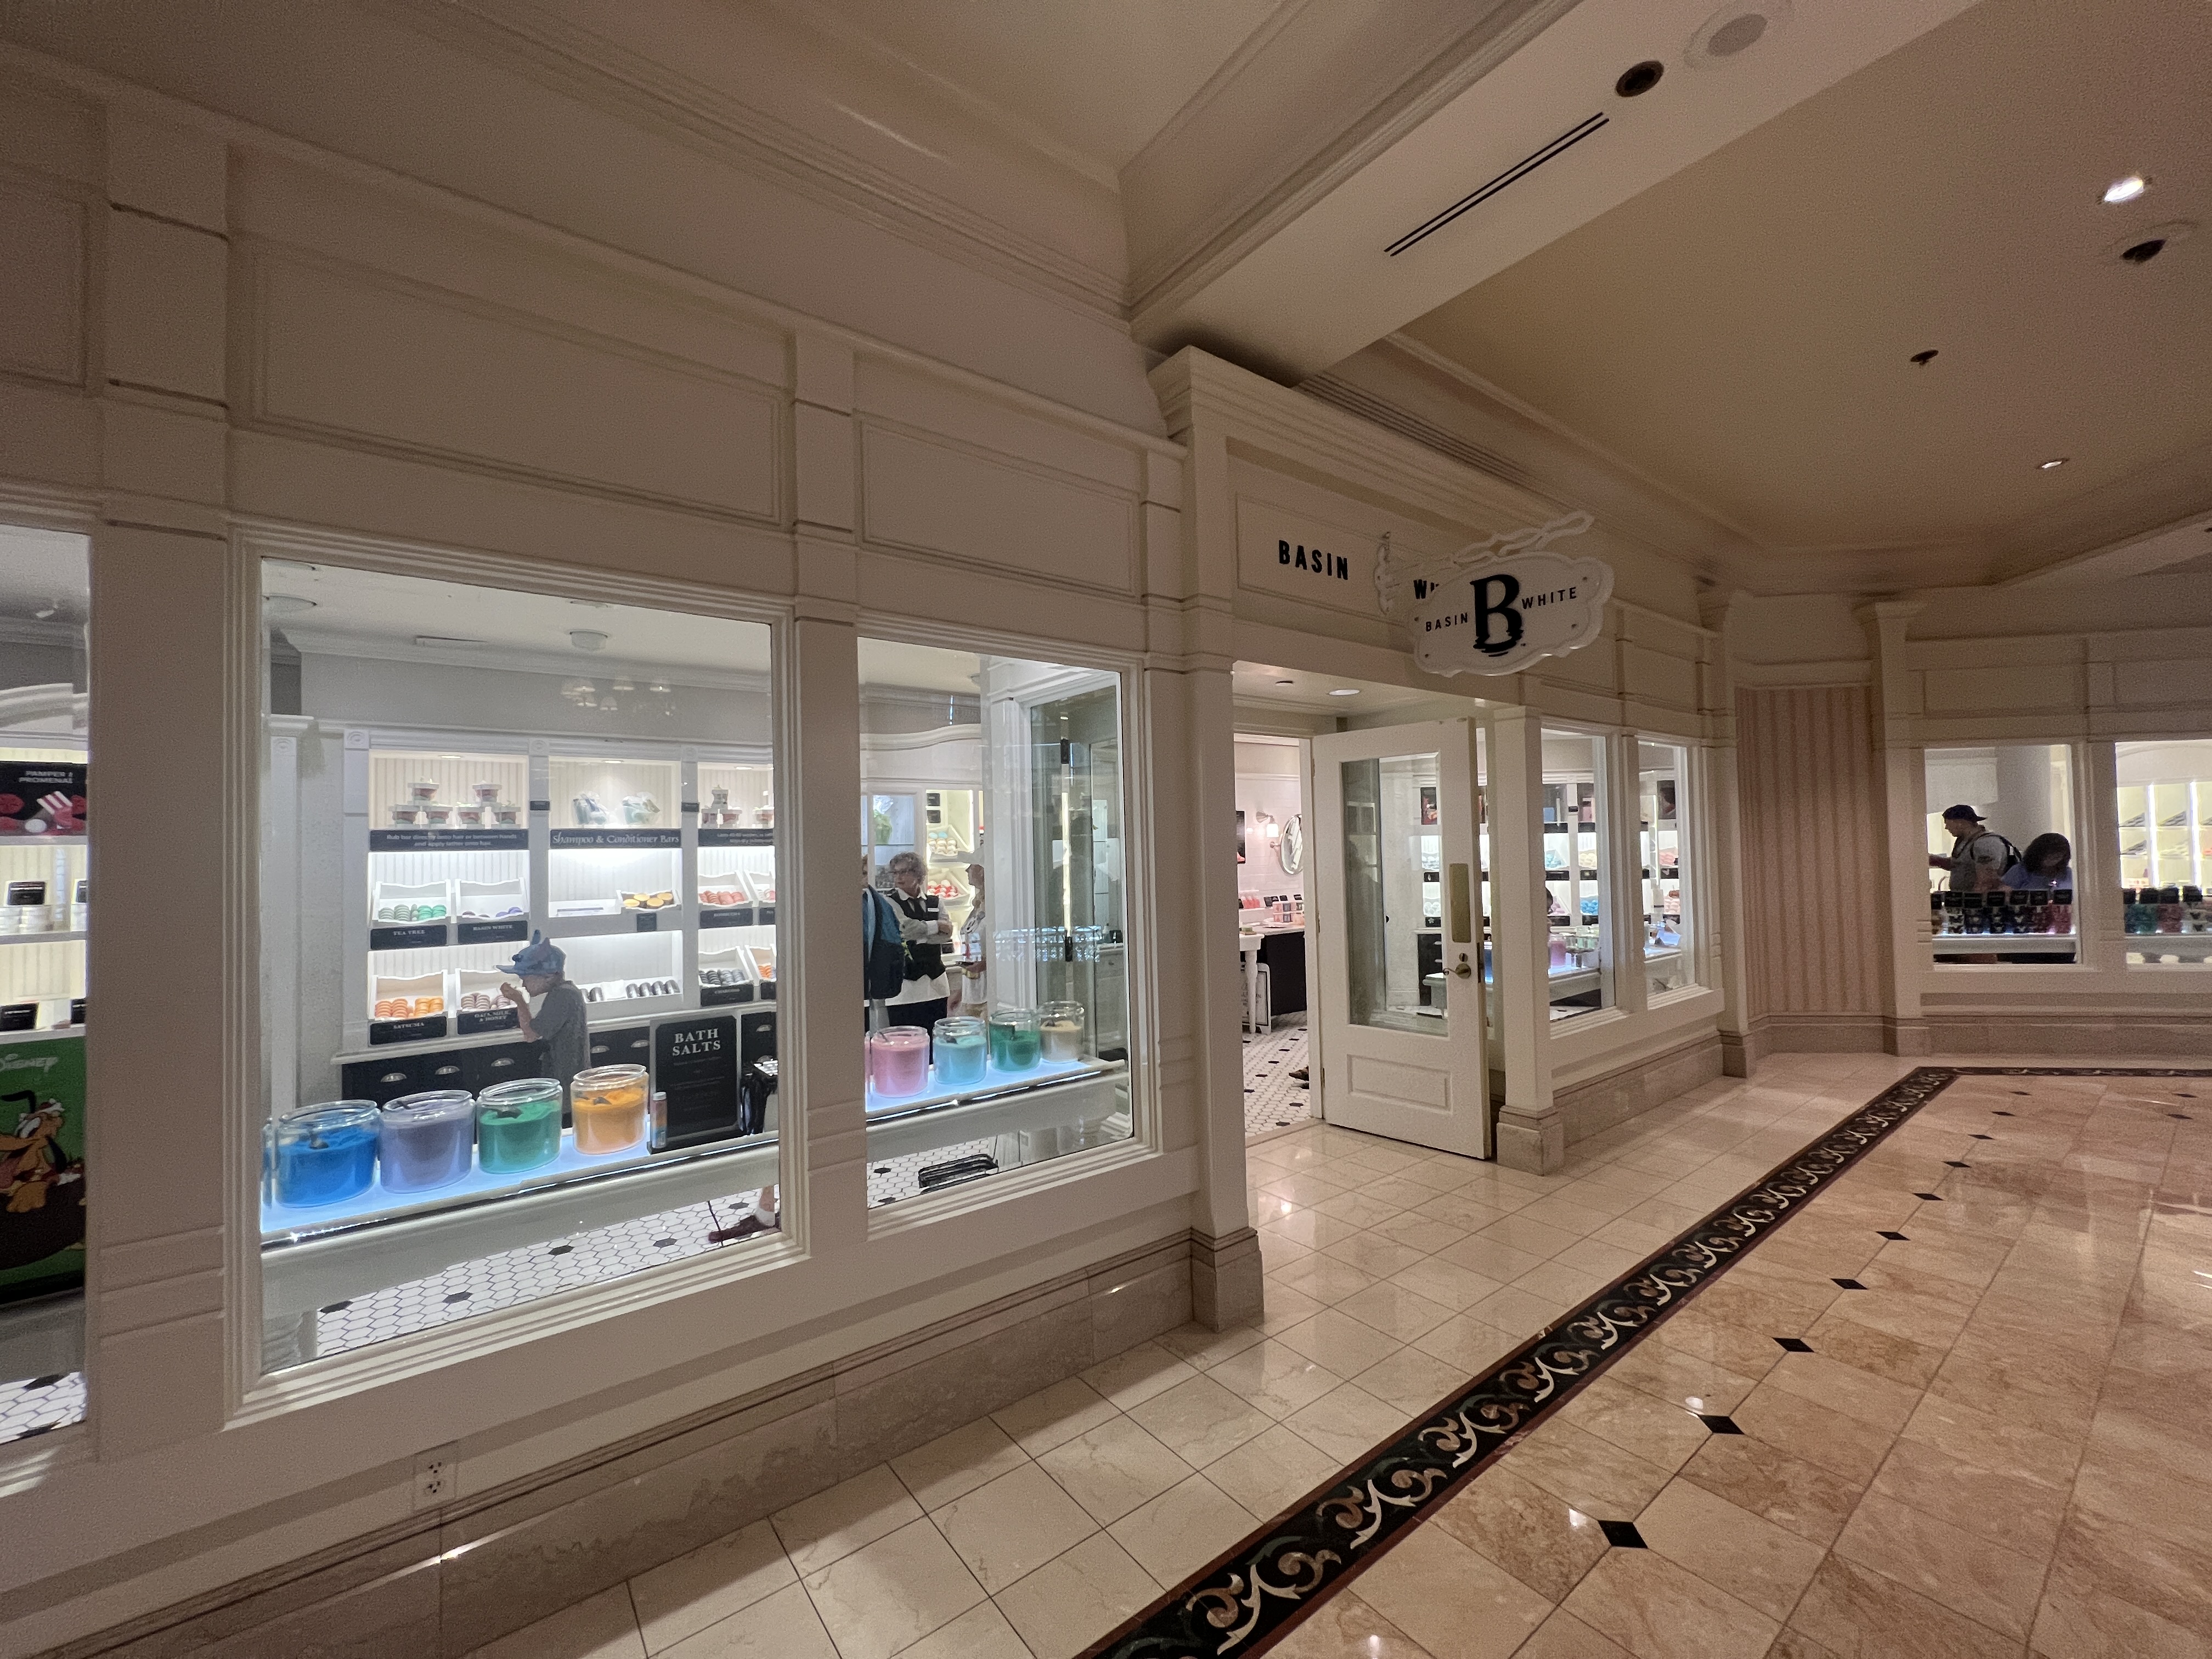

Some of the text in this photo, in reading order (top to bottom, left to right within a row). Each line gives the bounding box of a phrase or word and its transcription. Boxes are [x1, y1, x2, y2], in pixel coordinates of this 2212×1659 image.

[1278, 539, 1348, 580] BASIN
[1425, 574, 1577, 657] BASIN B WHITE
[553, 831, 679, 846] Shampoo & Conditioner Bars
[674, 1028, 719, 1043] BATH
[672, 1040, 721, 1056] SALTS
